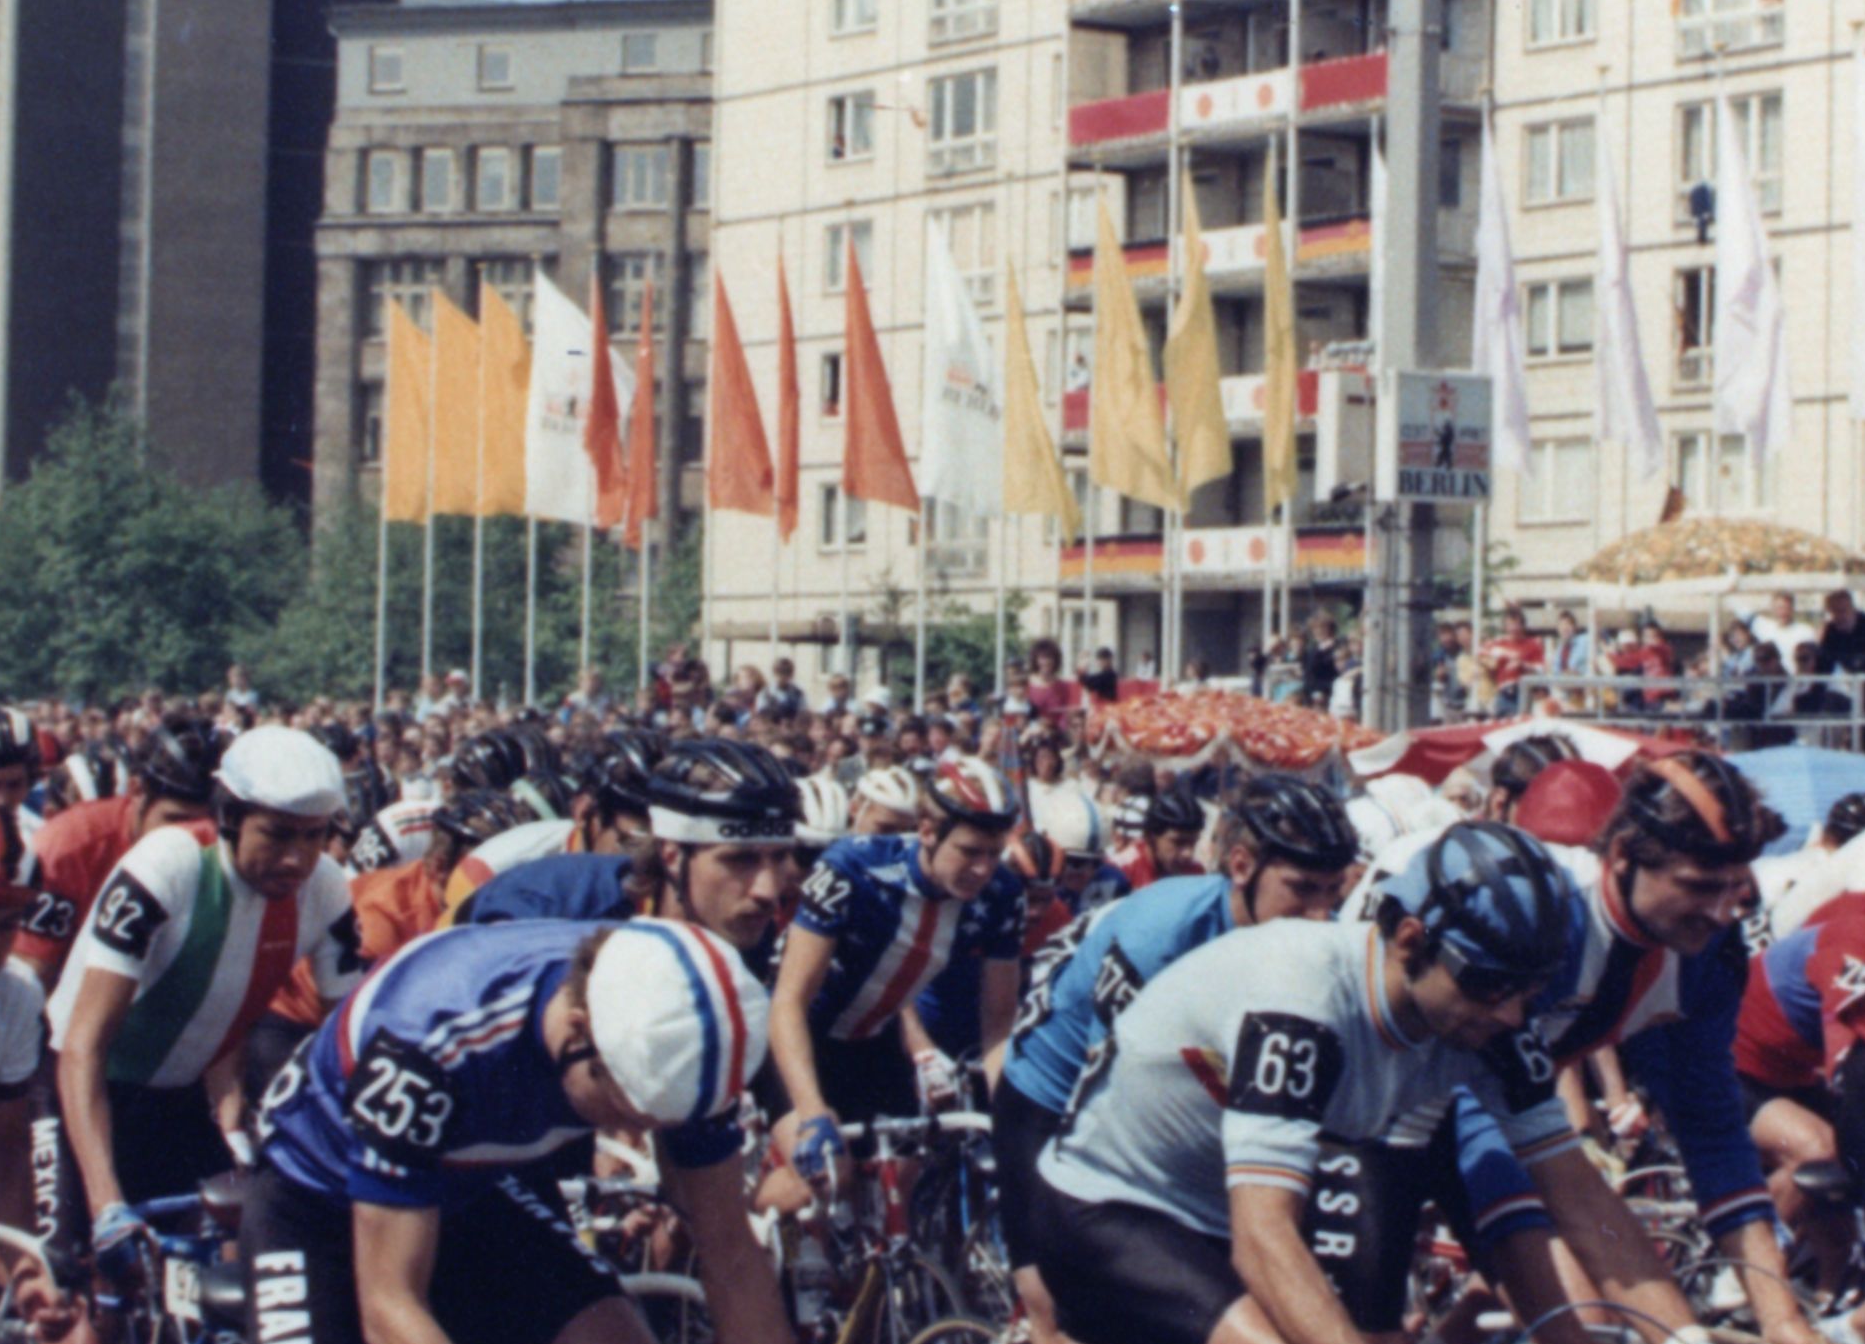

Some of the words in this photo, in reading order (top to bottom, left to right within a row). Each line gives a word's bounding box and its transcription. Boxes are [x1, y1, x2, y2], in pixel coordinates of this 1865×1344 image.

[1399, 470, 1490, 496] BERLIN
[20, 891, 75, 937] 23
[97, 885, 145, 941] 92
[1255, 1032, 1318, 1099] 63
[352, 1056, 454, 1148] 253
